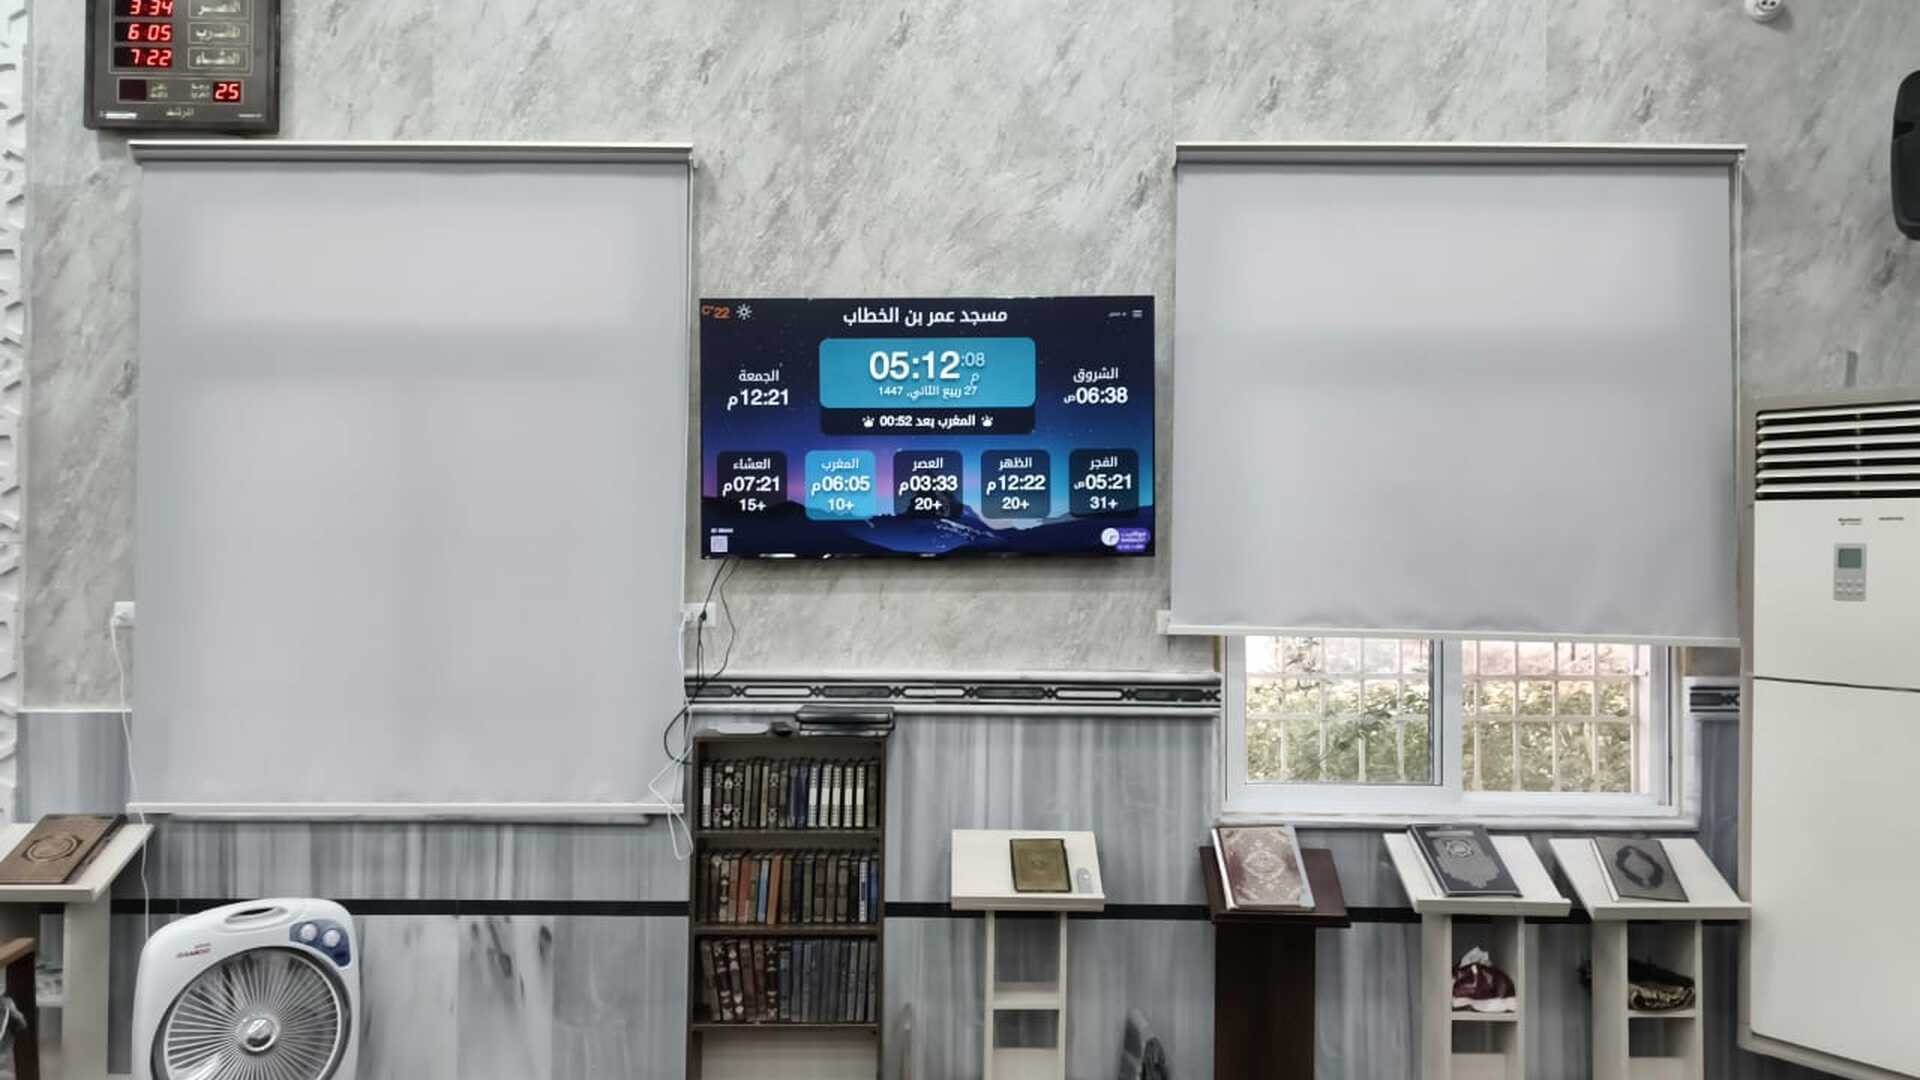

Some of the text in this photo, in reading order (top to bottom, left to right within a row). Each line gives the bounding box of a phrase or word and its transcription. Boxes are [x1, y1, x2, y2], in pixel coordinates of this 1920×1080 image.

[215, 83, 240, 100] 25
[843, 306, 1008, 327] مسجد عمر بن الخطاب
[869, 350, 961, 380] 05:12
[738, 369, 780, 385] الجمعة
[1072, 366, 1119, 384] الشروق
[878, 384, 905, 397] 1447
[941, 386, 963, 400] ربيع
[963, 385, 979, 397] 27
[879, 413, 976, 430] المغرب بعد 00:52
[732, 457, 771, 470] العشاء
[821, 457, 860, 472] المغرب
[911, 456, 944, 472] العصر
[998, 456, 1033, 471] الظهر
[1089, 455, 1118, 471] الفجر
